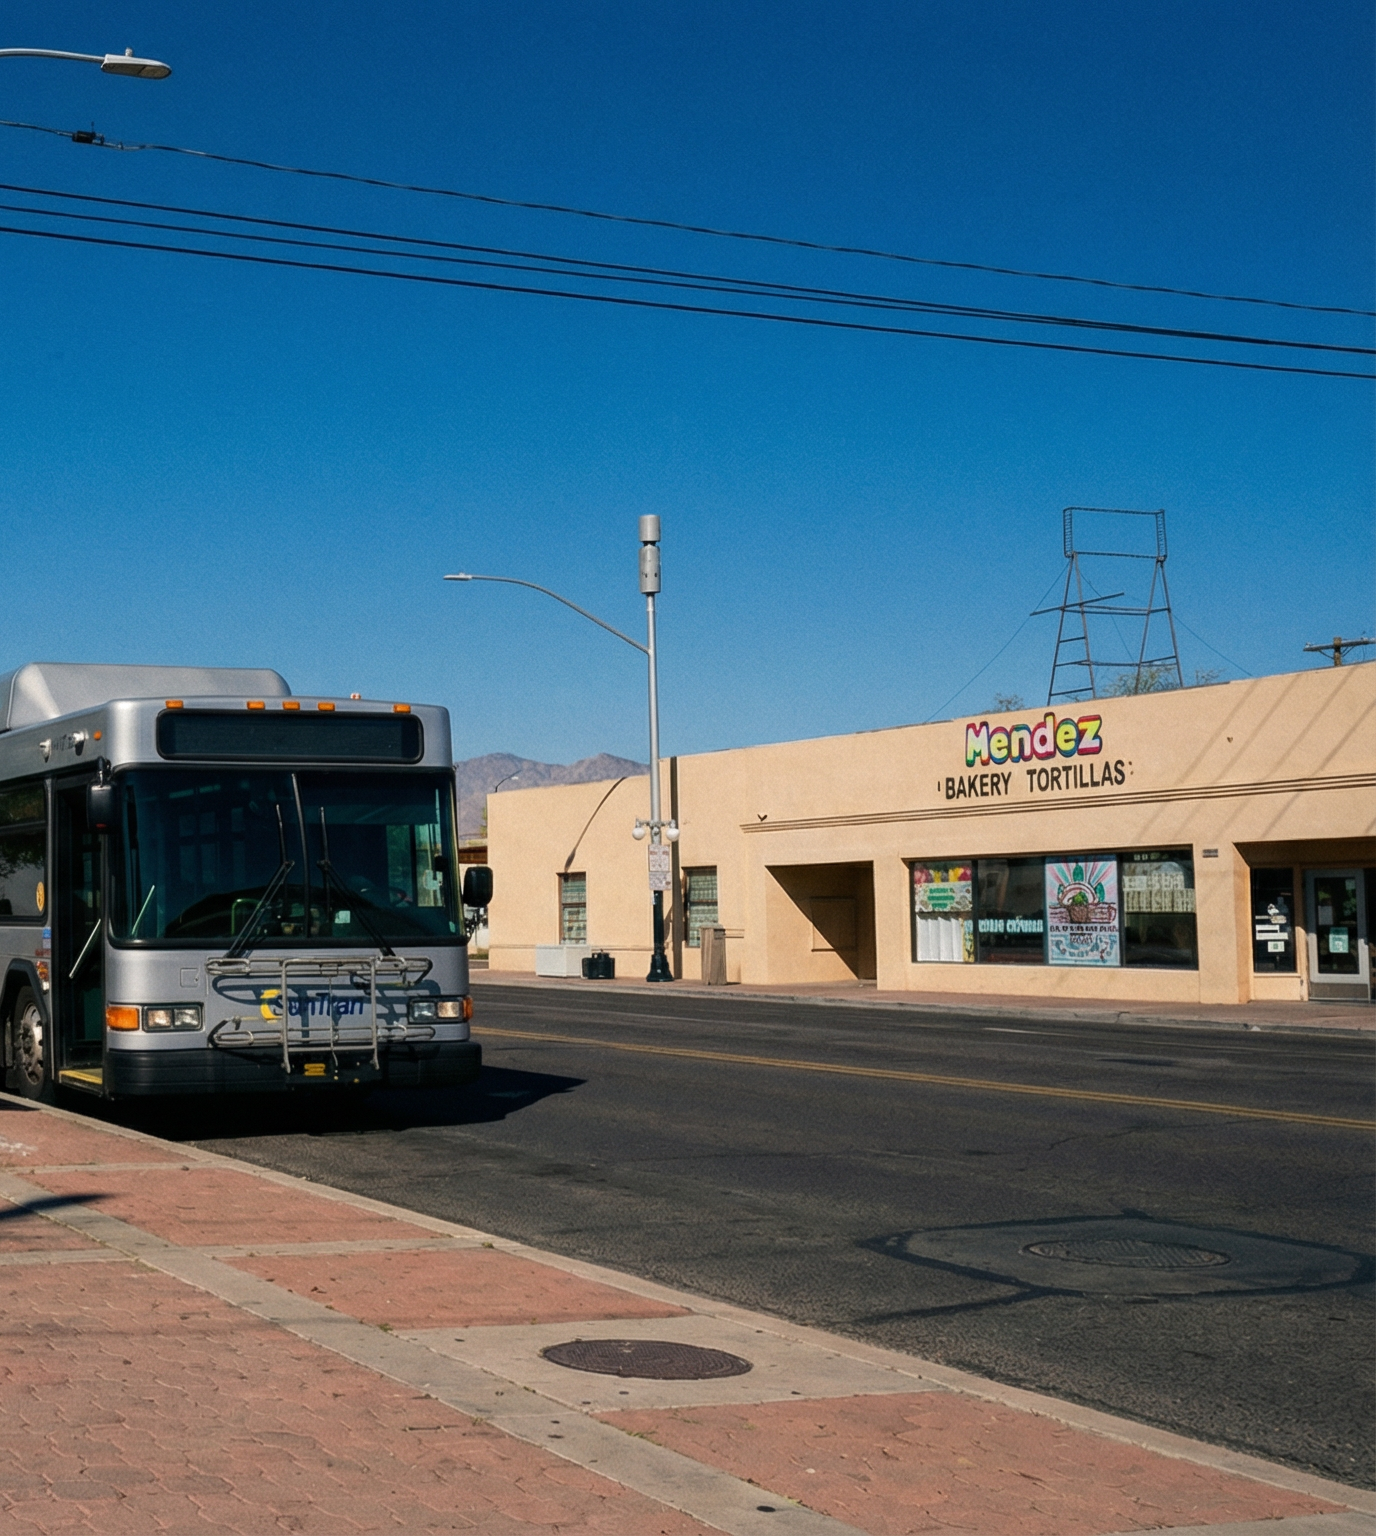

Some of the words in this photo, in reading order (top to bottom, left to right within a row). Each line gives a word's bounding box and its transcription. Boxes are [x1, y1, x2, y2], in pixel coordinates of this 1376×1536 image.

[966, 712, 1102, 767] Mendez
[945, 772, 1012, 800] BAKERY
[1026, 759, 1125, 793] TORTILLAS
